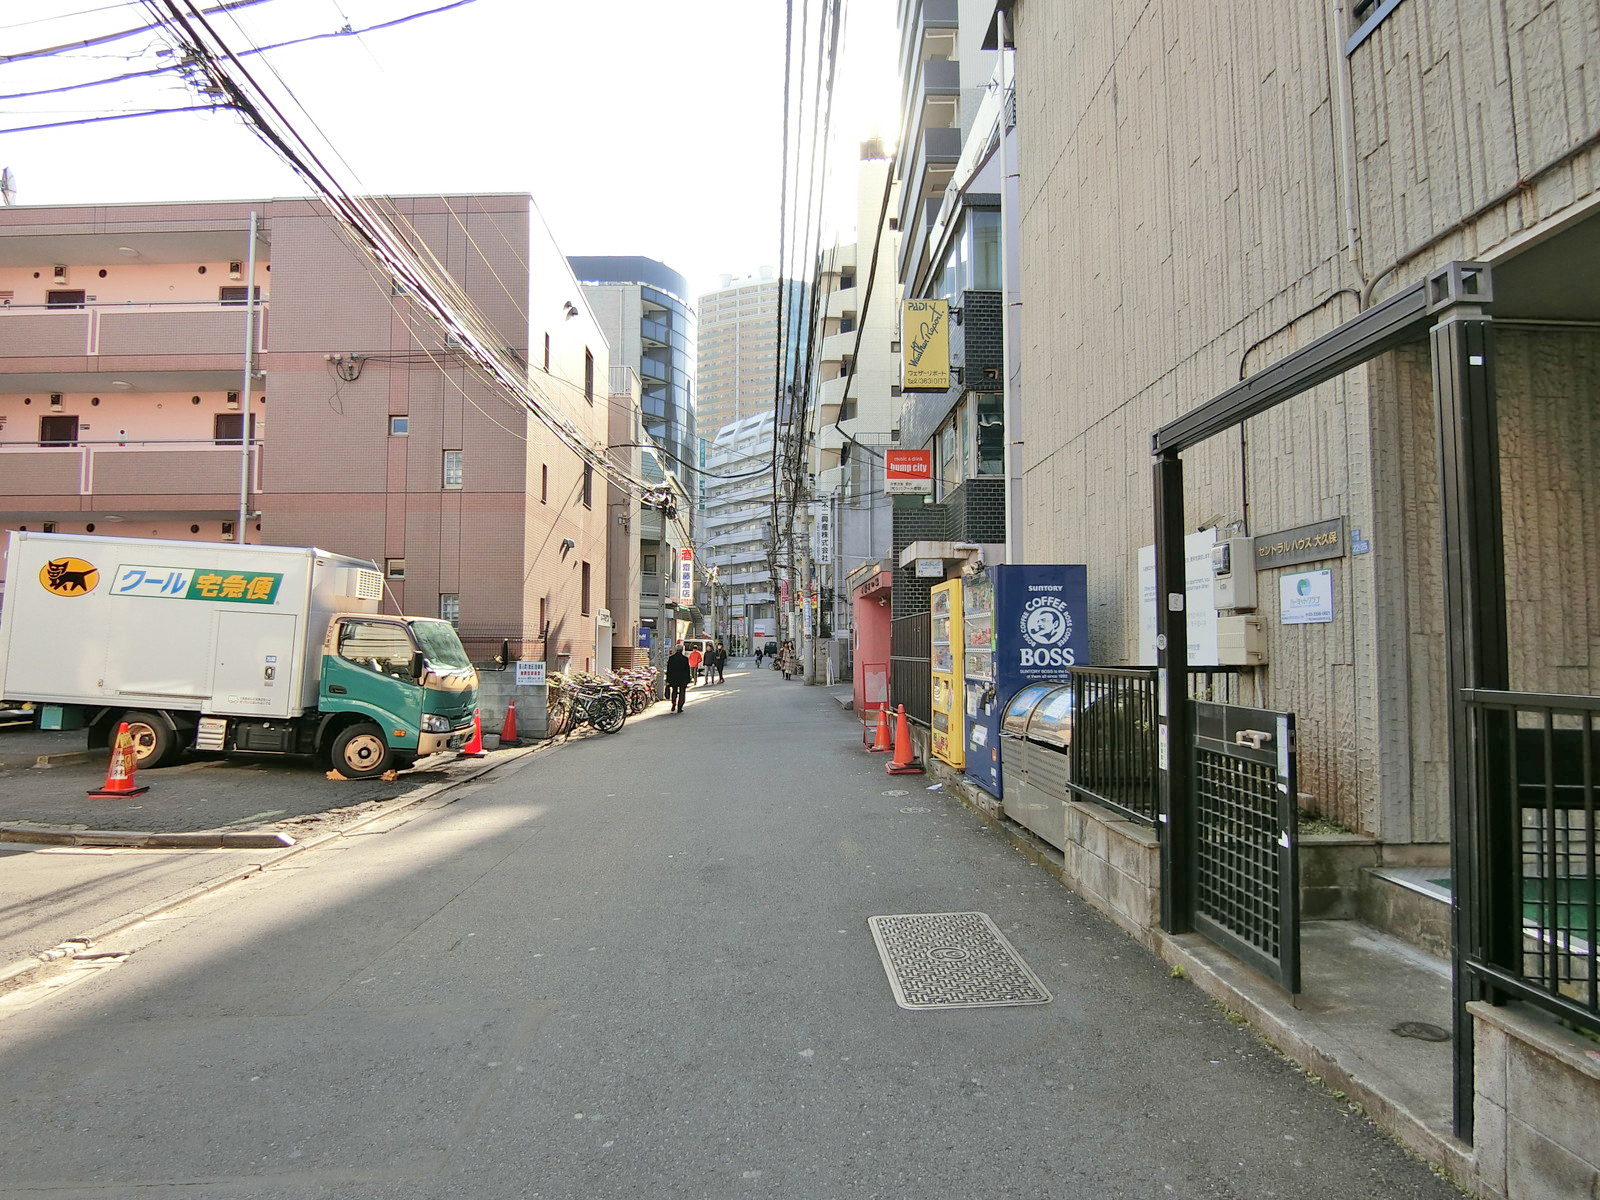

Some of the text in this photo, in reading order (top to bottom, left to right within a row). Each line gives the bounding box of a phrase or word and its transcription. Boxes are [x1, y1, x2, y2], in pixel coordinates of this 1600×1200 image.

[908, 302, 927, 311] PADI
[890, 462, 927, 473] bump city
[1258, 541, 1290, 557] セントラル
[1292, 537, 1313, 551] ハウス
[1314, 531, 1338, 547] 大久保
[682, 550, 692, 561] 酒
[120, 570, 187, 595] クール
[195, 573, 275, 600] 宅急便
[1025, 596, 1068, 612] COFFEE
[1020, 611, 1030, 634] COFFEE
[1020, 648, 1075, 667] BOSS
